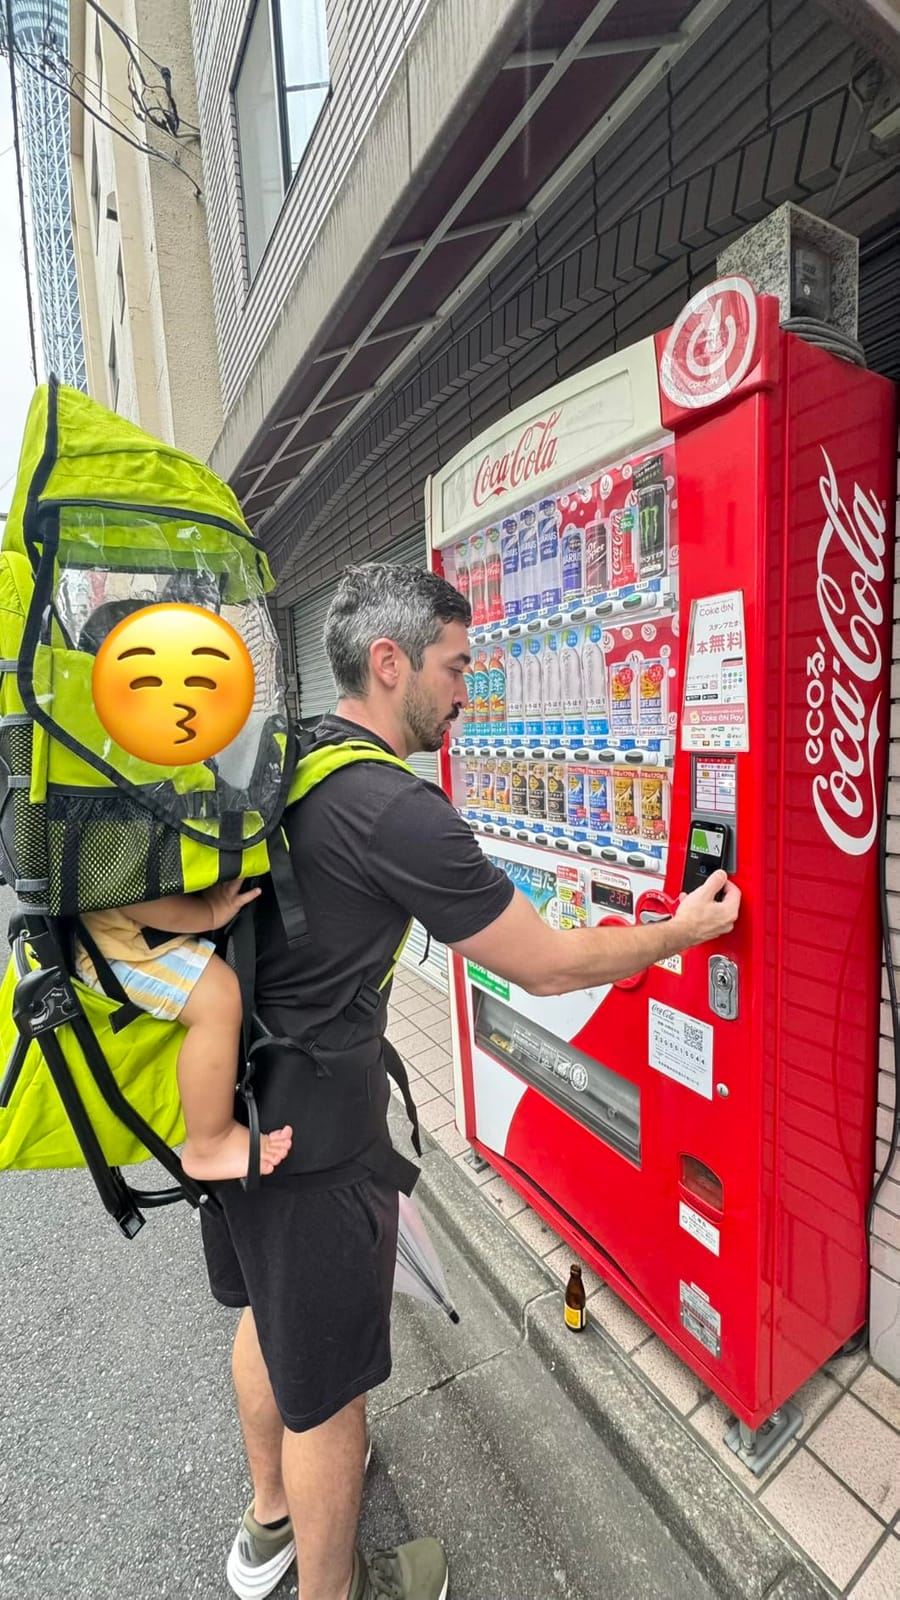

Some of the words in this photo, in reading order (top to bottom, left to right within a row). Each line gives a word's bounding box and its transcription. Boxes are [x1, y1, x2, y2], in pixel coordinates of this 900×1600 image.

[473, 406, 564, 507] Coca-Cola
[699, 607, 720, 616] Coke
[813, 444, 887, 856] Coca-Cola
[609, 890, 627, 907] 230
